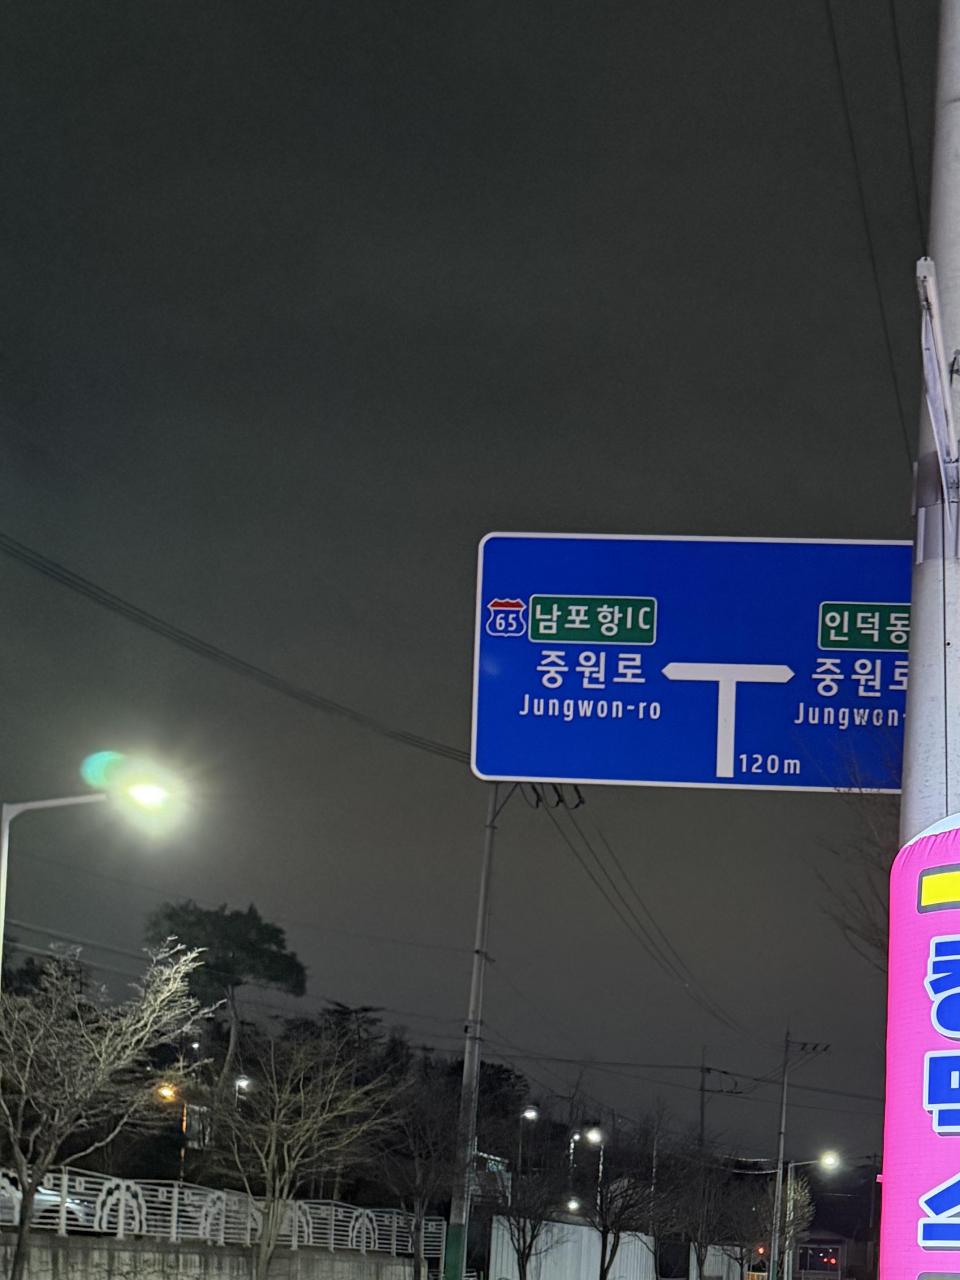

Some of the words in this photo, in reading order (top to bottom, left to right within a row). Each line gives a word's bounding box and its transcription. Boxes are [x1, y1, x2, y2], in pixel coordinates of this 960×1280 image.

[495, 613, 517, 631] 65
[535, 603, 651, 636] 남포항IC
[824, 611, 911, 644] 인덕동
[536, 650, 646, 689] 중원로
[518, 693, 661, 721] Jungwon-ro
[738, 753, 801, 775] 120m
